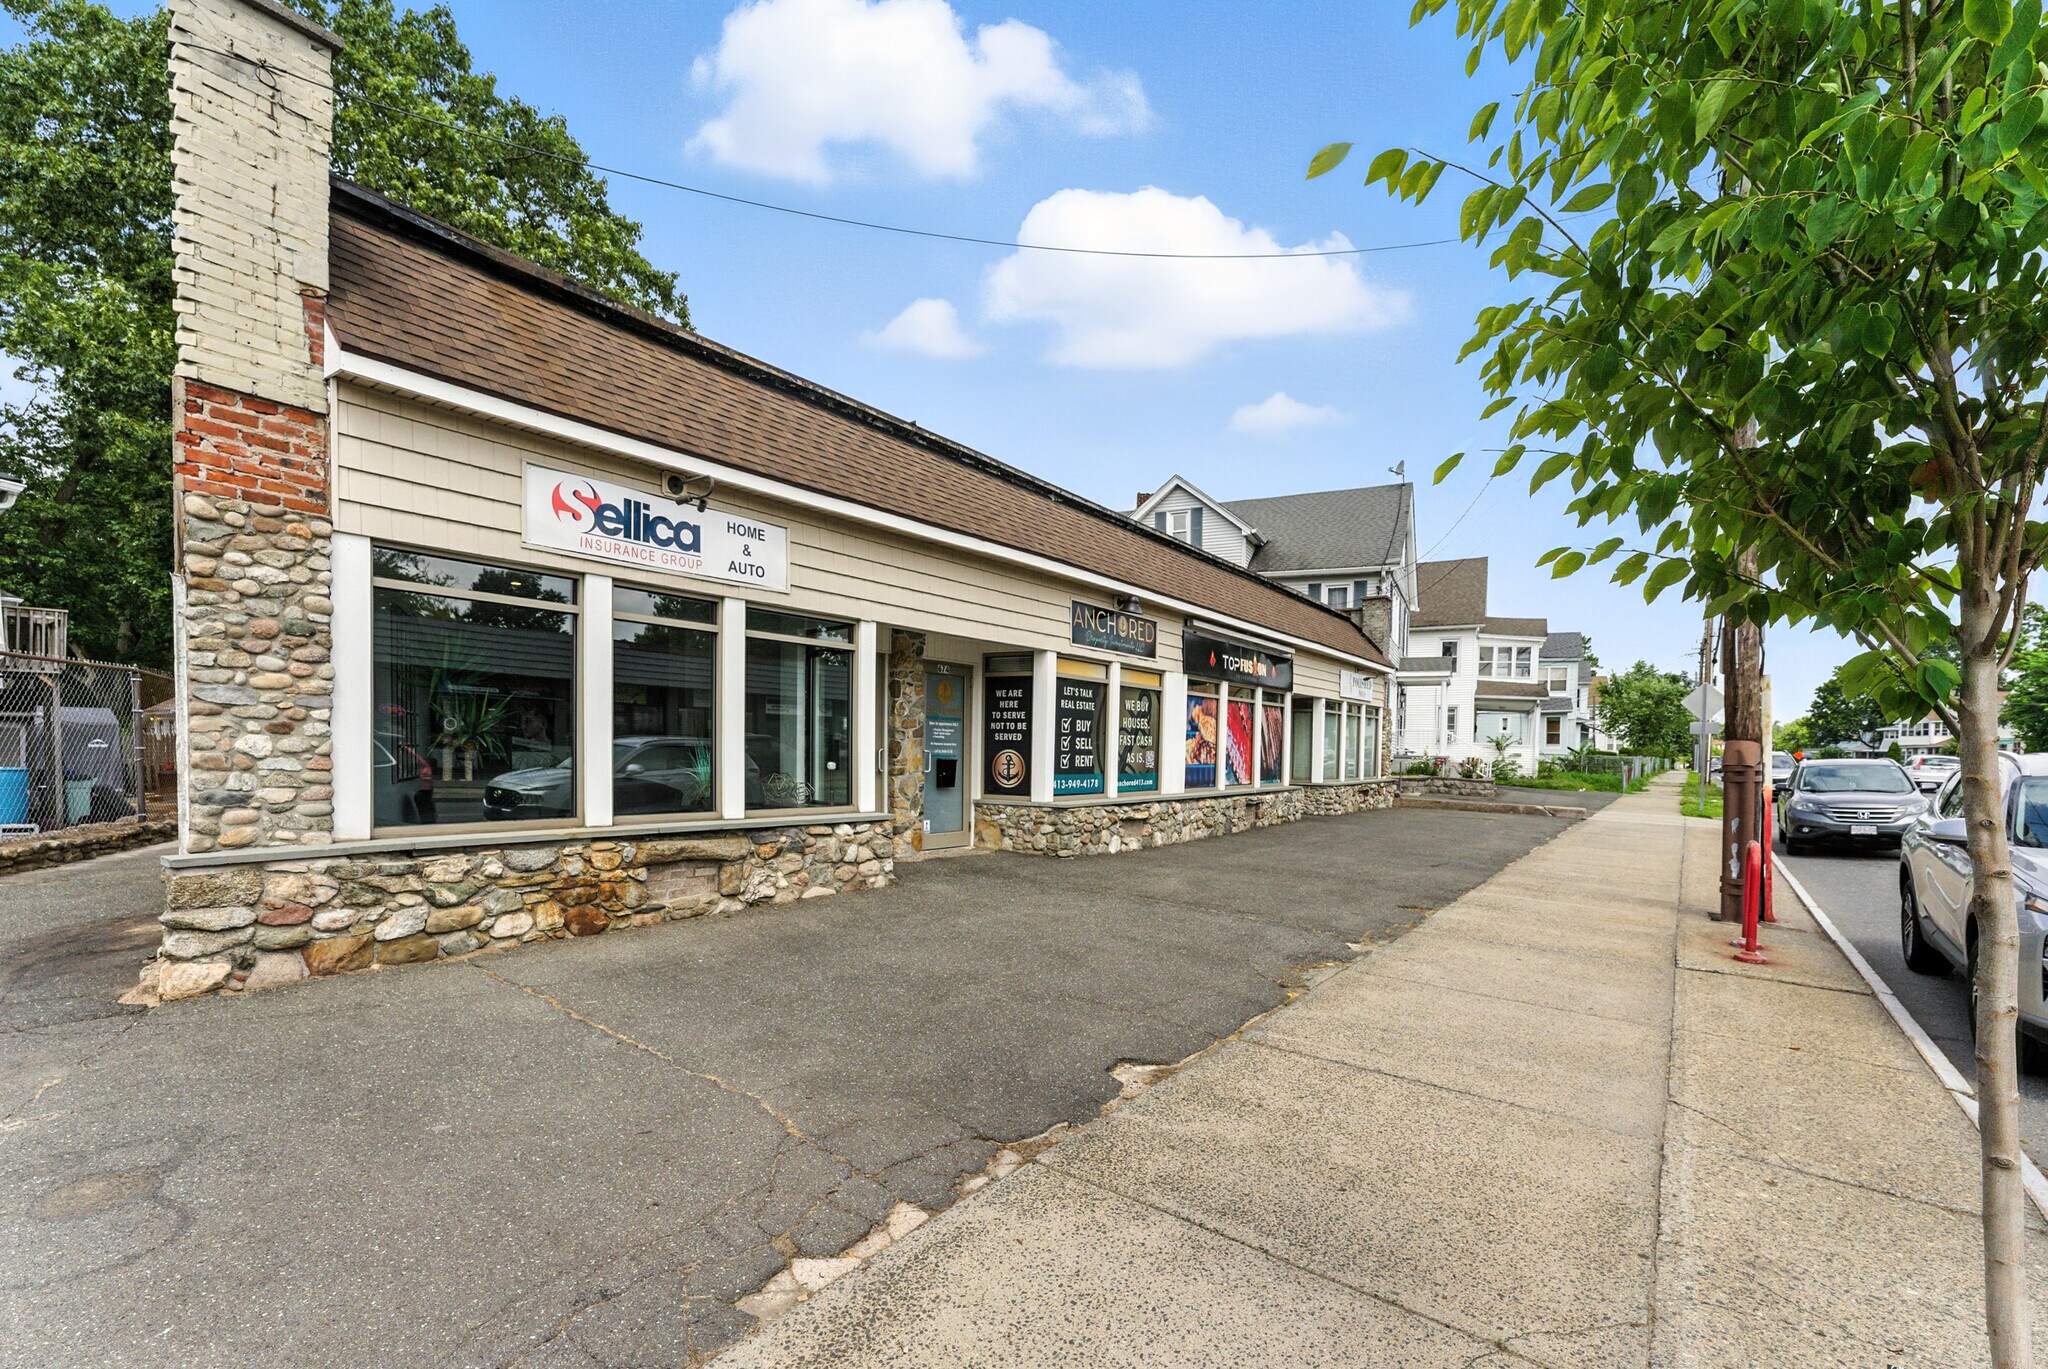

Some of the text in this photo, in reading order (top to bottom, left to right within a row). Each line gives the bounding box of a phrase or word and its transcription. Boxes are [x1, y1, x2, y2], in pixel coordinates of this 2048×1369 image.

[551, 480, 701, 553] Sellica
[727, 521, 766, 542] HOME
[579, 536, 703, 570] INSURANCE GROUP
[742, 544, 752, 557] &
[728, 560, 765, 578] AUTO
[1073, 606, 1155, 643] ANCHORED
[995, 689, 1023, 698] WE ARE
[1063, 686, 1093, 698] LET'S TALK
[999, 700, 1019, 708] HERE
[1061, 699, 1095, 711] REAL ESTATE
[1124, 699, 1150, 712] WE BUY
[992, 711, 1026, 719] TO SERVE
[990, 722, 1027, 730] NOT TO BE
[1076, 719, 1092, 732] BUY
[994, 733, 1023, 741] SERVED
[1119, 735, 1153, 747] FAST CASH
[1075, 737, 1093, 750] SELL
[1075, 755, 1094, 767] RENT
[1126, 752, 1135, 764] AS
[1053, 779, 1099, 789] 413-949-4178
